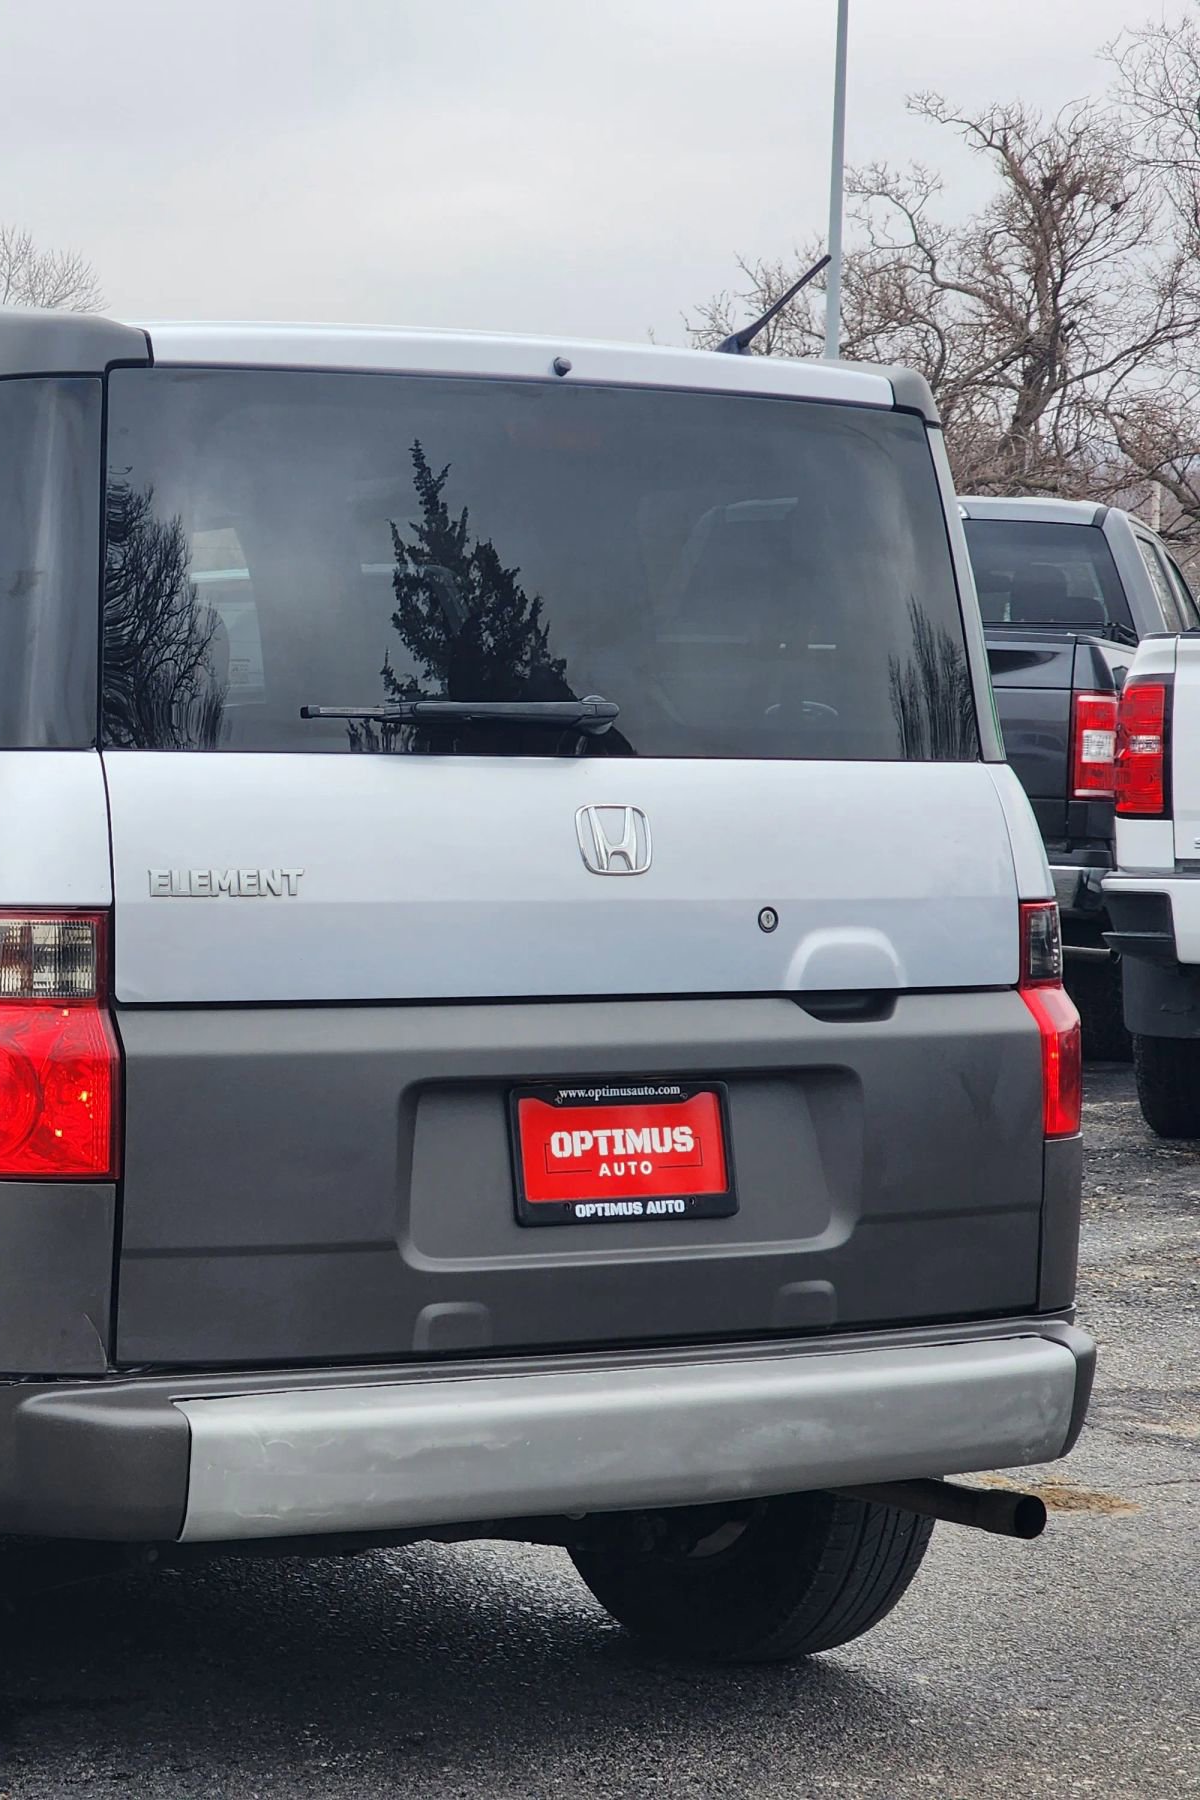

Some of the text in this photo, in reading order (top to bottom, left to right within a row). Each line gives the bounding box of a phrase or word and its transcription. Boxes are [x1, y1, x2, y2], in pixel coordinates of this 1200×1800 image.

[148, 868, 305, 898] ELEMENT
[558, 1085, 681, 1101] www.optimusauto.com
[550, 1126, 694, 1159] OPTIMUS
[599, 1161, 653, 1177] AUTO
[575, 1199, 685, 1218] OPTIMUS AUTO
